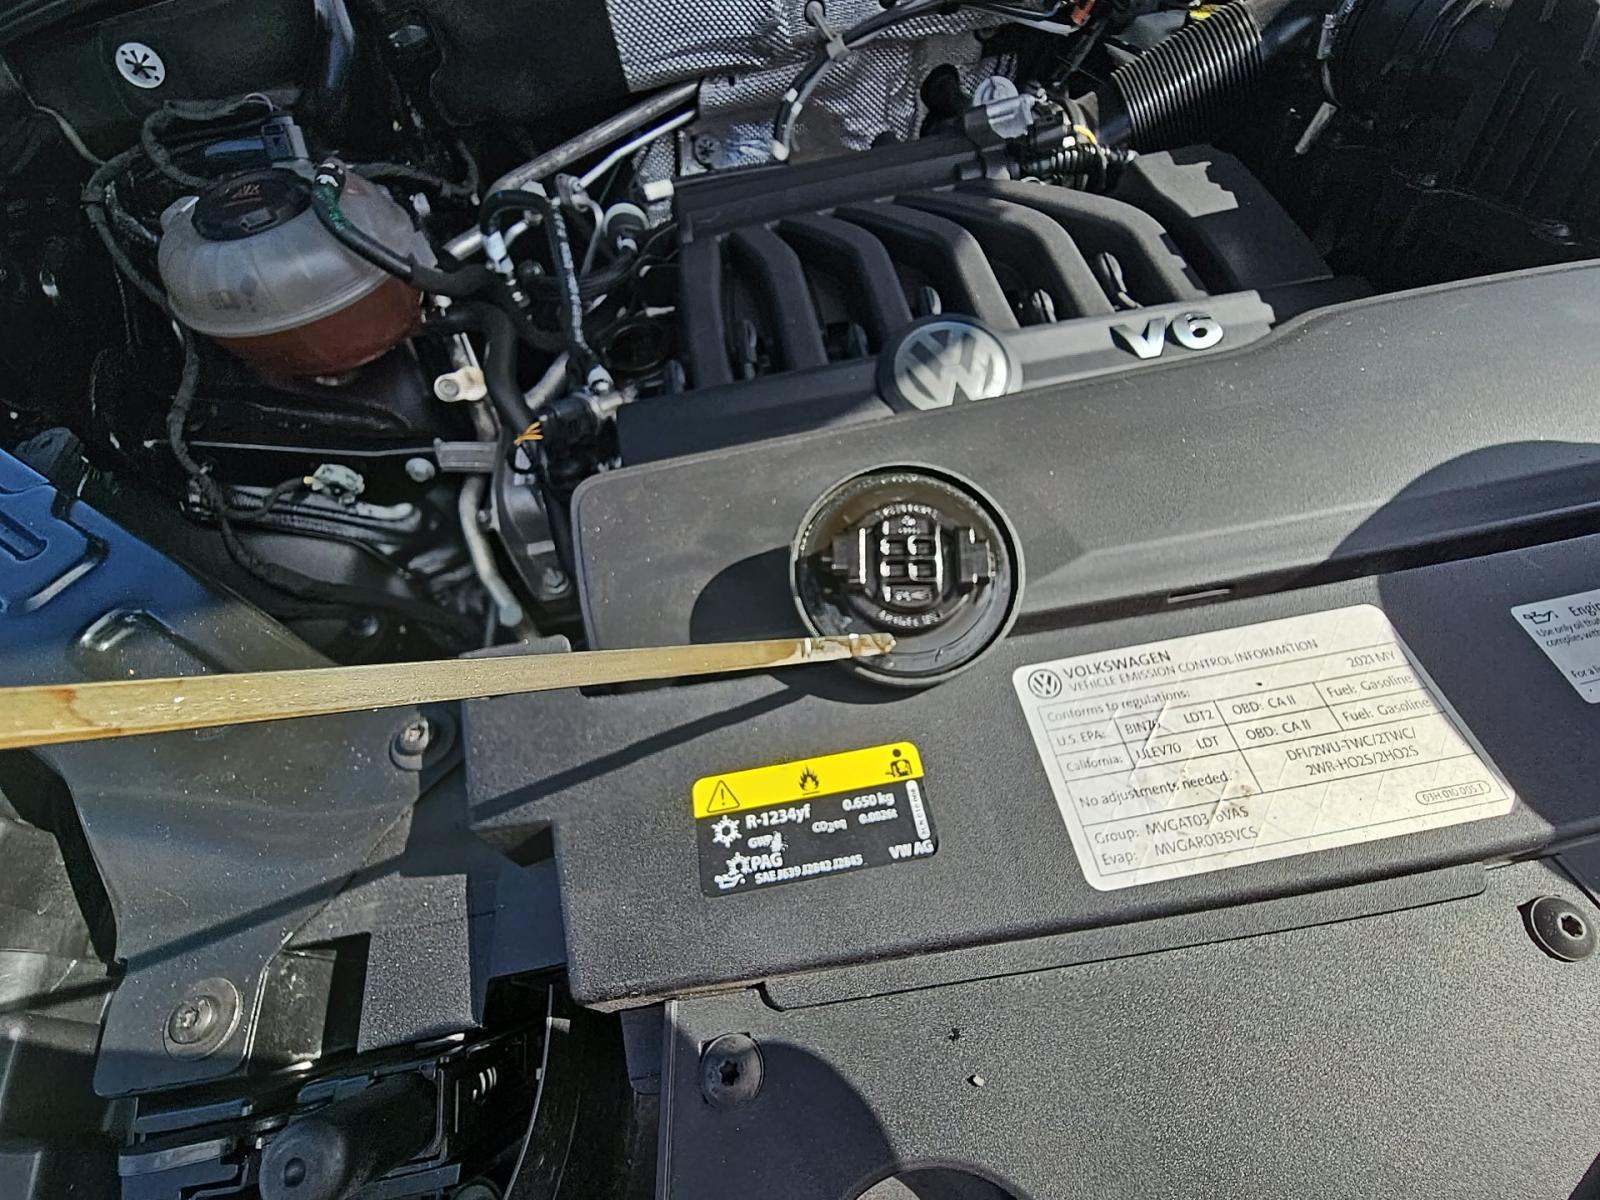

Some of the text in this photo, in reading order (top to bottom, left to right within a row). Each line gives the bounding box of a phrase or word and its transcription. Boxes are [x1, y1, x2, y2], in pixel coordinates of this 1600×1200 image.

[1110, 314, 1224, 359] V6
[1063, 650, 1171, 680] VOLKSWAGEN
[1069, 639, 1319, 692] VEHICLE EMISSION CONTROL INFORMATION
[1326, 673, 1414, 699] Fuel: Gasoline
[1047, 689, 1191, 723] Conforms to regulations:
[1231, 702, 1264, 715] OBD:
[1267, 697, 1286, 709] CA
[1341, 698, 1432, 723] Fuel: Gasoline
[1081, 729, 1106, 742] EPA:
[1183, 709, 1215, 724] LDT2
[1246, 725, 1279, 741] OBD:
[1282, 721, 1301, 734] CA
[1066, 754, 1123, 773] California:
[1195, 735, 1220, 751] LDT
[842, 791, 896, 811] 0.650 kg
[1079, 796, 1099, 808] No
[1101, 781, 1180, 806] adjustments
[745, 803, 811, 830] R-1234yf
[1094, 827, 1140, 845] Group:
[750, 852, 784, 873] PAG
[888, 839, 935, 860] VW AG
[1101, 851, 1138, 868] Evap:
